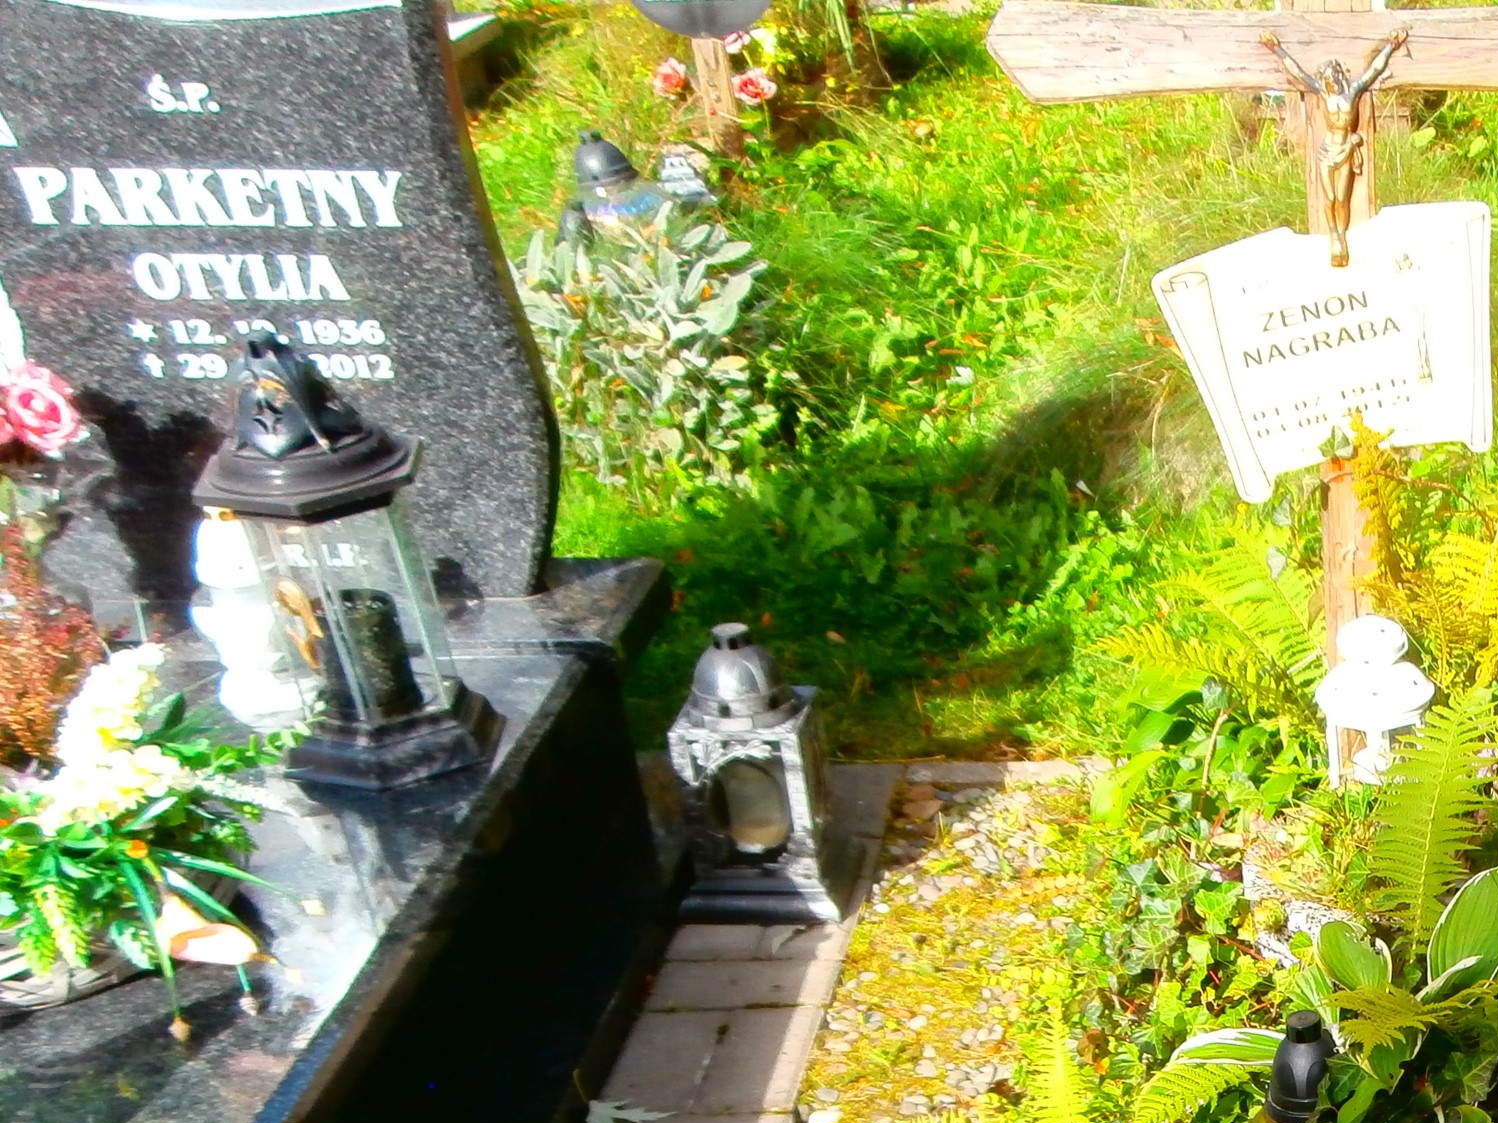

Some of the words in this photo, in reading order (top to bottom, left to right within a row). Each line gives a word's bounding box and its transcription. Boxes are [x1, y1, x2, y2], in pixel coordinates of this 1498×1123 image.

[13, 167, 403, 228] PARKETNY
[133, 253, 351, 301] OTYLIA
[1261, 290, 1369, 333] ZENON
[1241, 316, 1401, 368] NAGRABA
